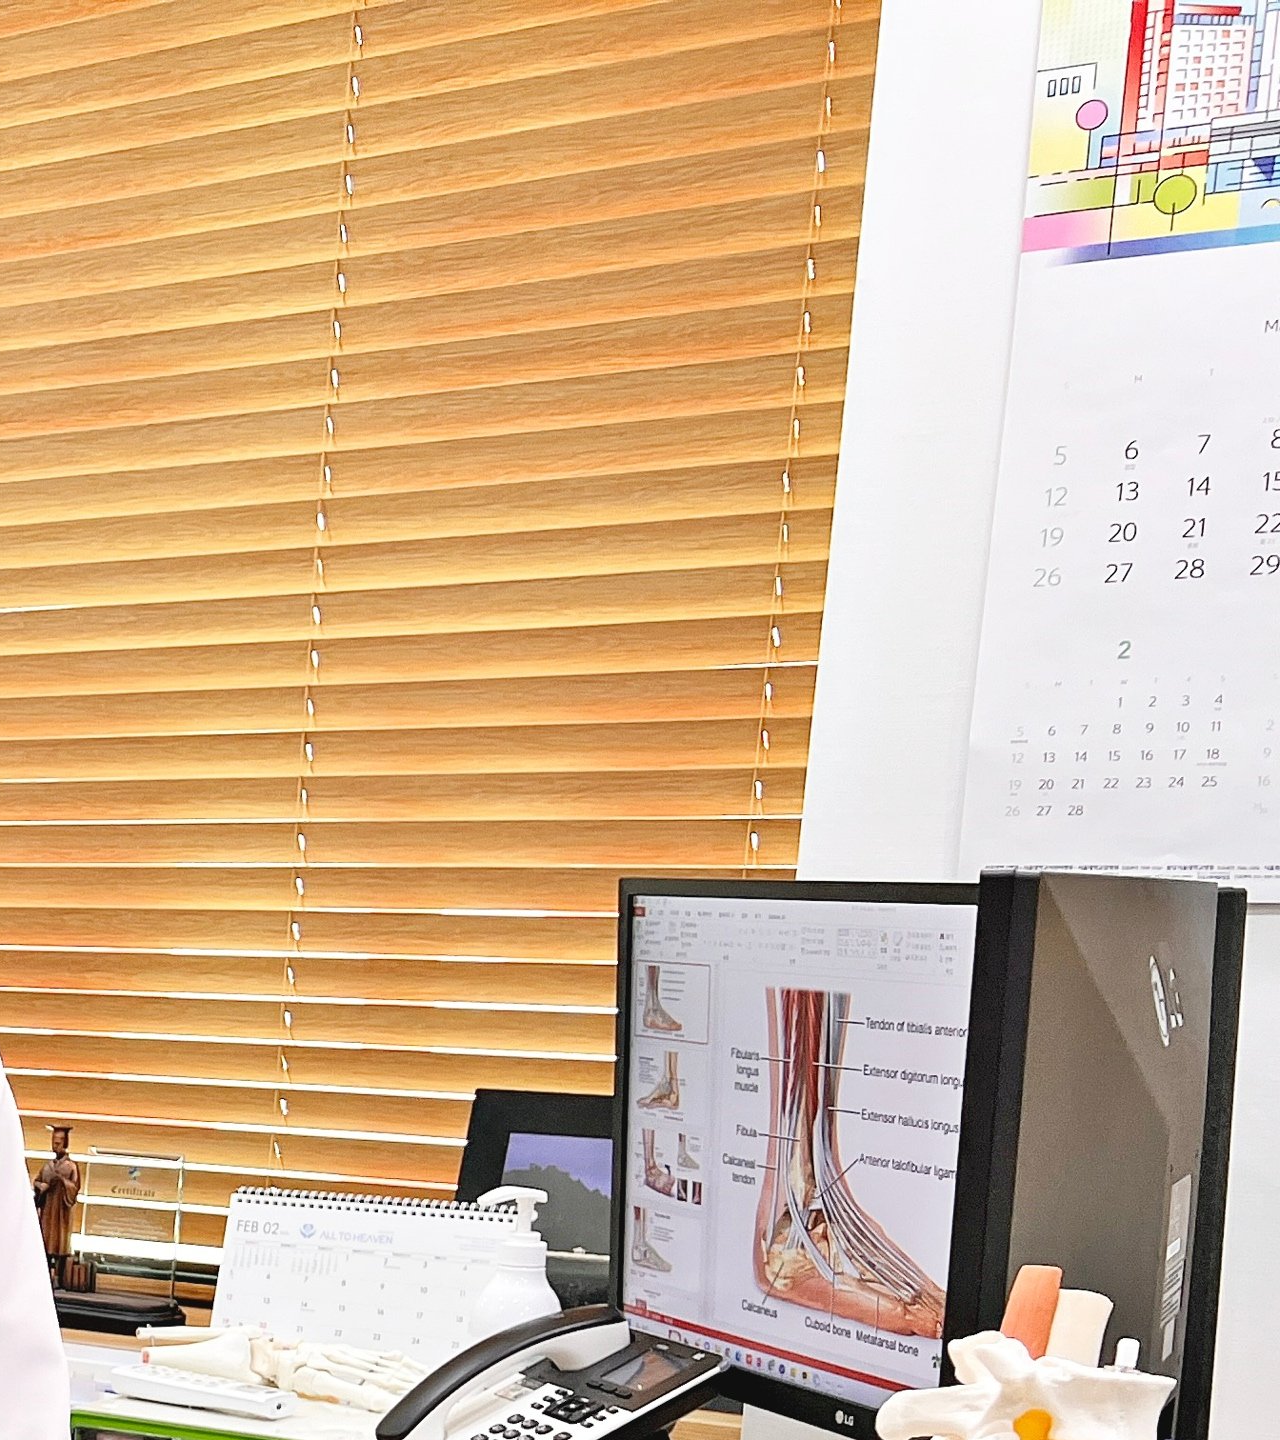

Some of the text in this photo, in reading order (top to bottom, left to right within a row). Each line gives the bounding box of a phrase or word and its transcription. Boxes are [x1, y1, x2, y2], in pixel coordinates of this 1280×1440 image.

[1264, 319, 1280, 334] M
[1053, 445, 1068, 466] 5
[1124, 440, 1139, 460] 6
[1197, 434, 1212, 455] 7
[1044, 486, 1068, 507] 12
[1116, 481, 1139, 502] 13
[1187, 476, 1211, 497] 14
[1040, 513, 1280, 548] 19 20 21 22
[1033, 555, 1280, 588] 26 27 28 29
[1117, 640, 1131, 660] 2
[1118, 694, 1223, 708] 1 2 3 4
[1017, 720, 1221, 737] 5 6 7 8 9 10 11
[1011, 748, 1220, 763] 12 13 14 15 16 17 18
[1009, 776, 1217, 790] 19 20 21 22 23 24 25
[1005, 805, 1084, 816] 26 27 28
[865, 1017, 967, 1038] Tendon of tibialis anterior
[737, 1064, 759, 1078] longus
[863, 1064, 898, 1079] Extensor
[900, 1069, 938, 1084] digitorum
[734, 1081, 758, 1093] muscle
[861, 1108, 959, 1135] Extensor hallucis longus
[736, 1124, 757, 1138] Fibula
[859, 1153, 891, 1168] Anterior
[892, 1159, 932, 1175] talofibular
[732, 1172, 756, 1185] tendon
[111, 1185, 155, 1197] Certificate
[236, 1219, 280, 1236] FEB 02
[320, 1231, 393, 1245] ALL TO HEAVEN
[742, 1299, 778, 1318] Calcaneus
[804, 1316, 851, 1338] Cuboid bone
[411, 1337, 420, 1345] 24
[856, 1330, 919, 1356] Metatarsal bone
